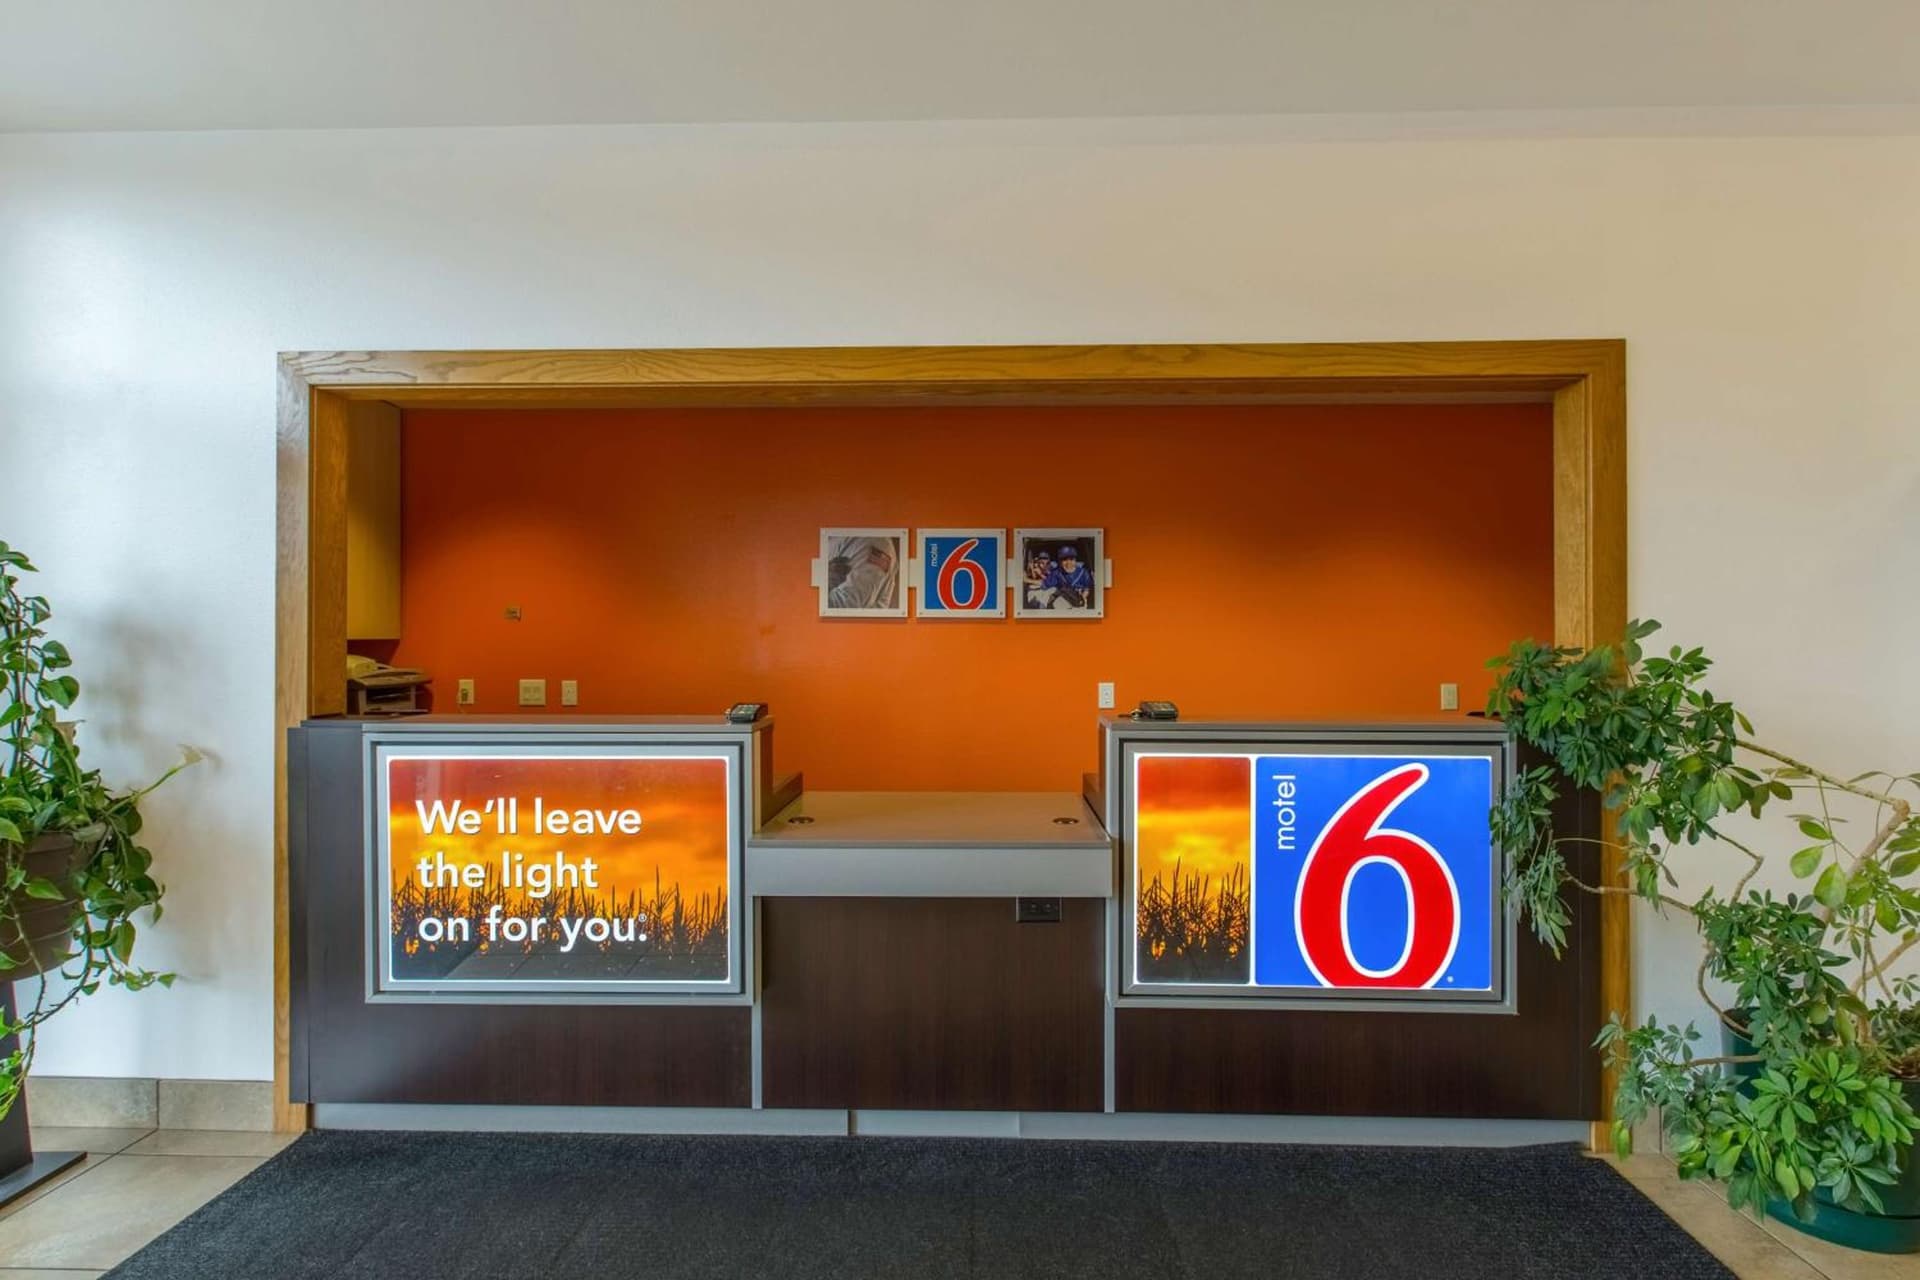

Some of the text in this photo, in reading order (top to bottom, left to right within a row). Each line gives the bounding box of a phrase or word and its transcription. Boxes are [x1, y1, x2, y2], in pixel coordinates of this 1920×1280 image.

[937, 538, 989, 611] 6
[415, 797, 642, 835] We'll leave
[1272, 774, 1297, 851] motel
[416, 851, 599, 898] the light
[1294, 762, 1461, 990] 6
[418, 916, 469, 942] on
[486, 905, 548, 942] for
